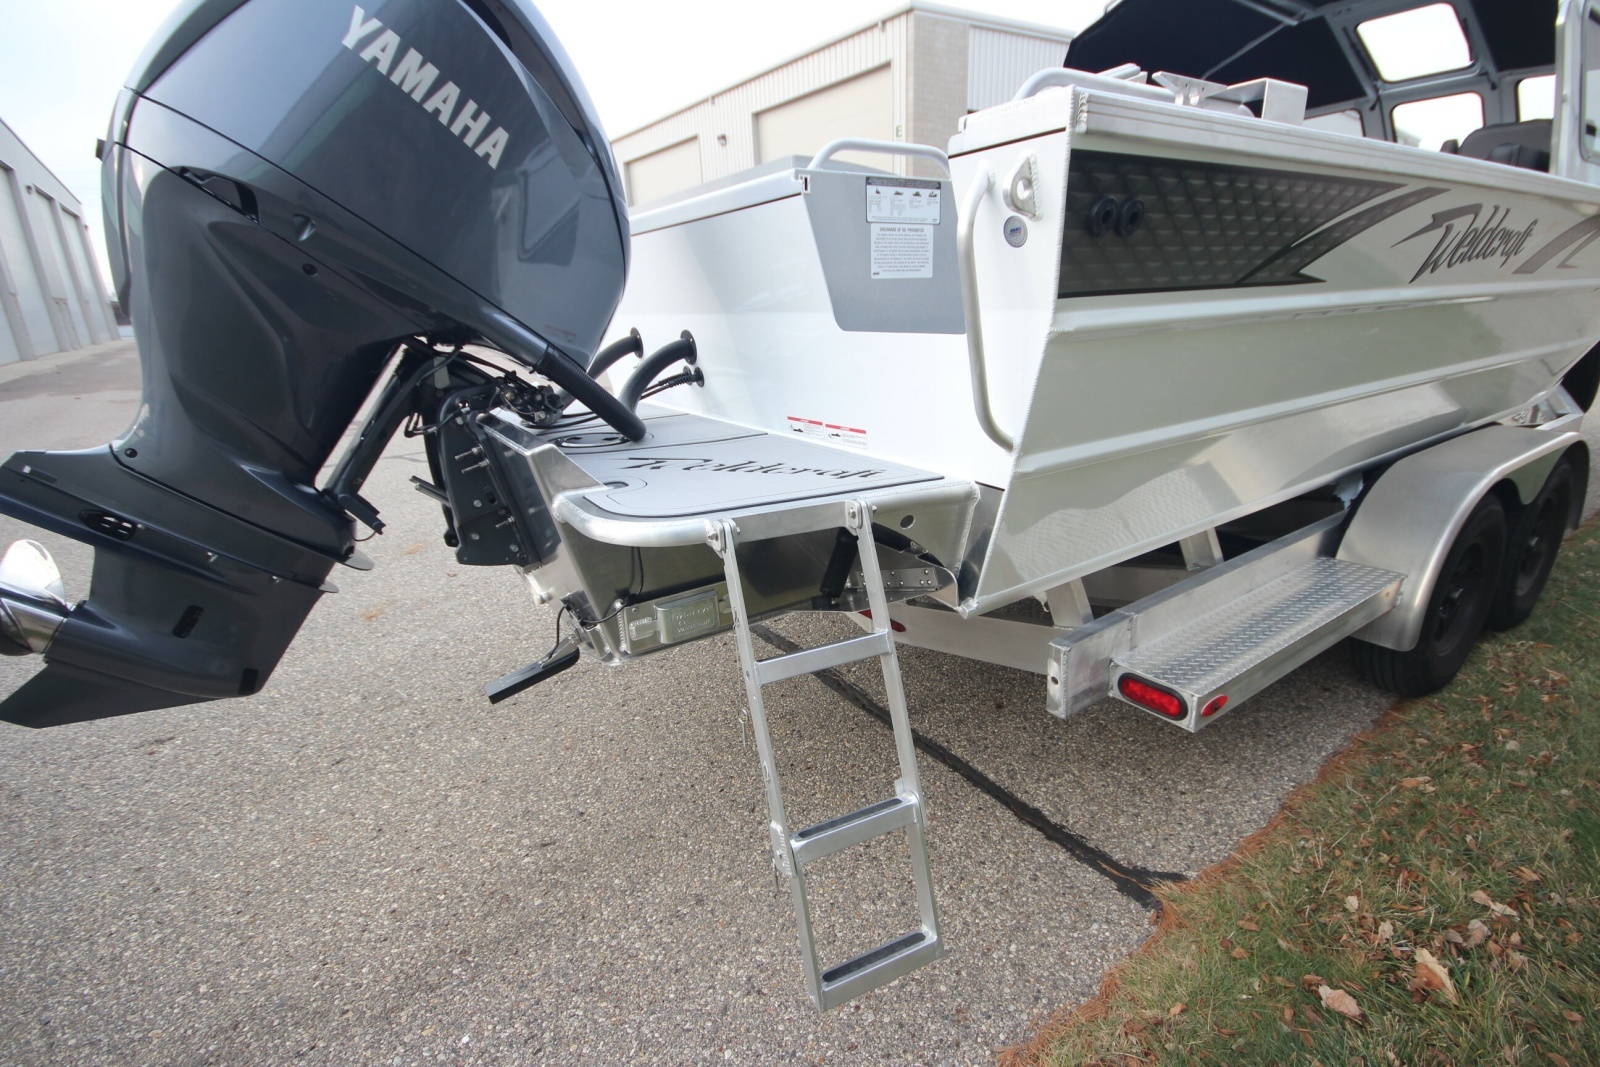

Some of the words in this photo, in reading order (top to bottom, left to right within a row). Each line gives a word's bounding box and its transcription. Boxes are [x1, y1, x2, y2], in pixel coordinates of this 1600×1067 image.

[341, 4, 510, 170] YAMAHA
[1390, 202, 1539, 284] Weldcraft
[620, 456, 888, 480] Weldcraft
